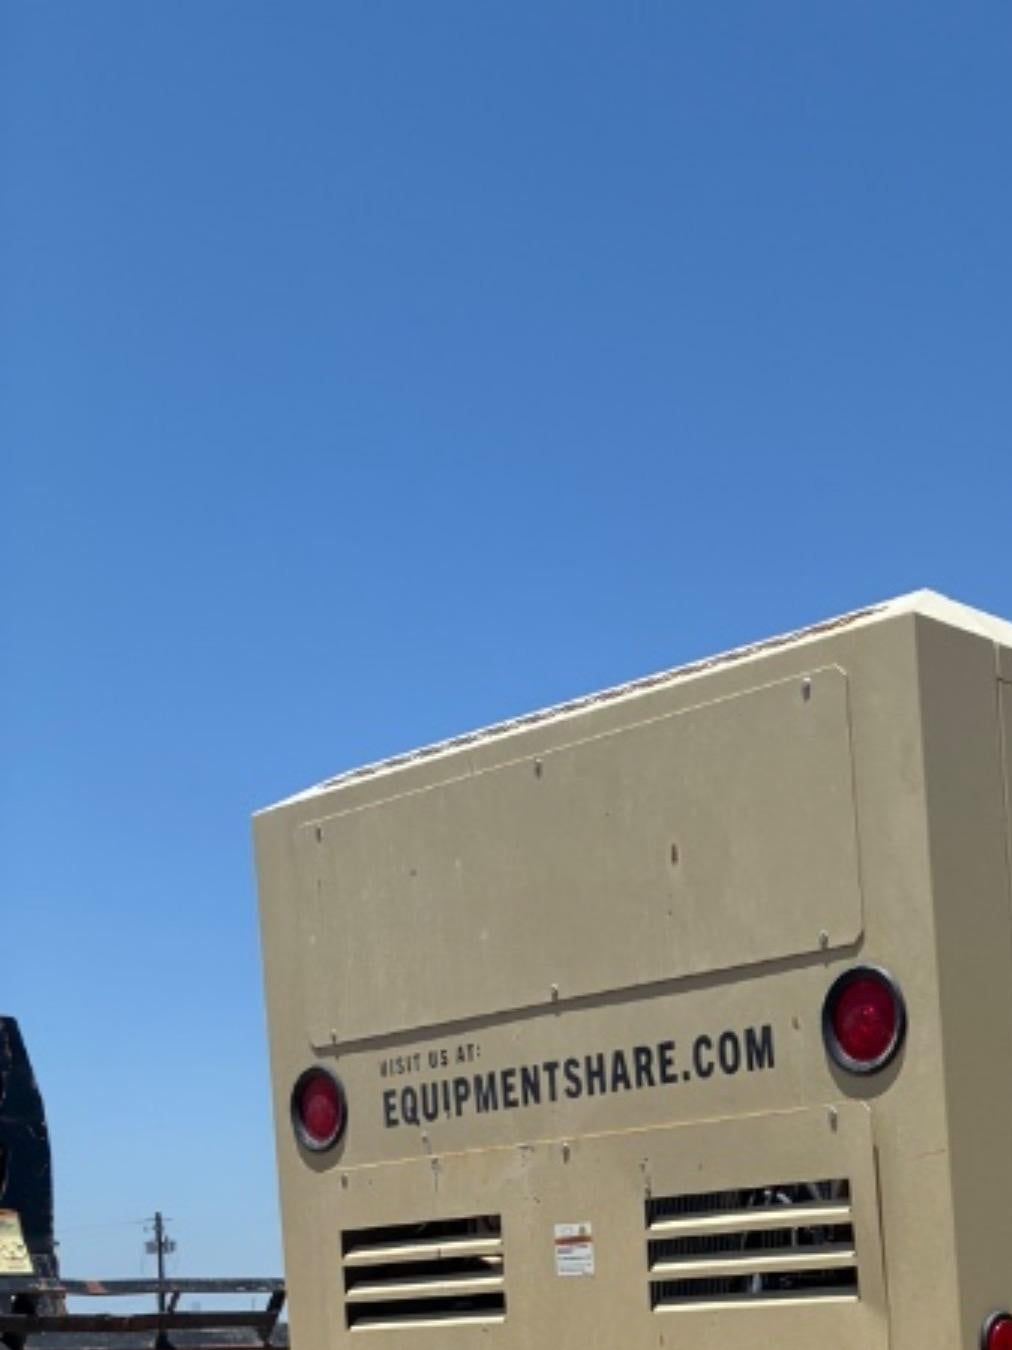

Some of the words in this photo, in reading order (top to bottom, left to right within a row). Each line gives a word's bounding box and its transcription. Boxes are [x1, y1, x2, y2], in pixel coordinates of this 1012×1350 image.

[383, 1023, 777, 1129] EQUIPMENTSHARE.COM
[428, 1049, 449, 1070] US
[456, 1043, 481, 1065] AT:
